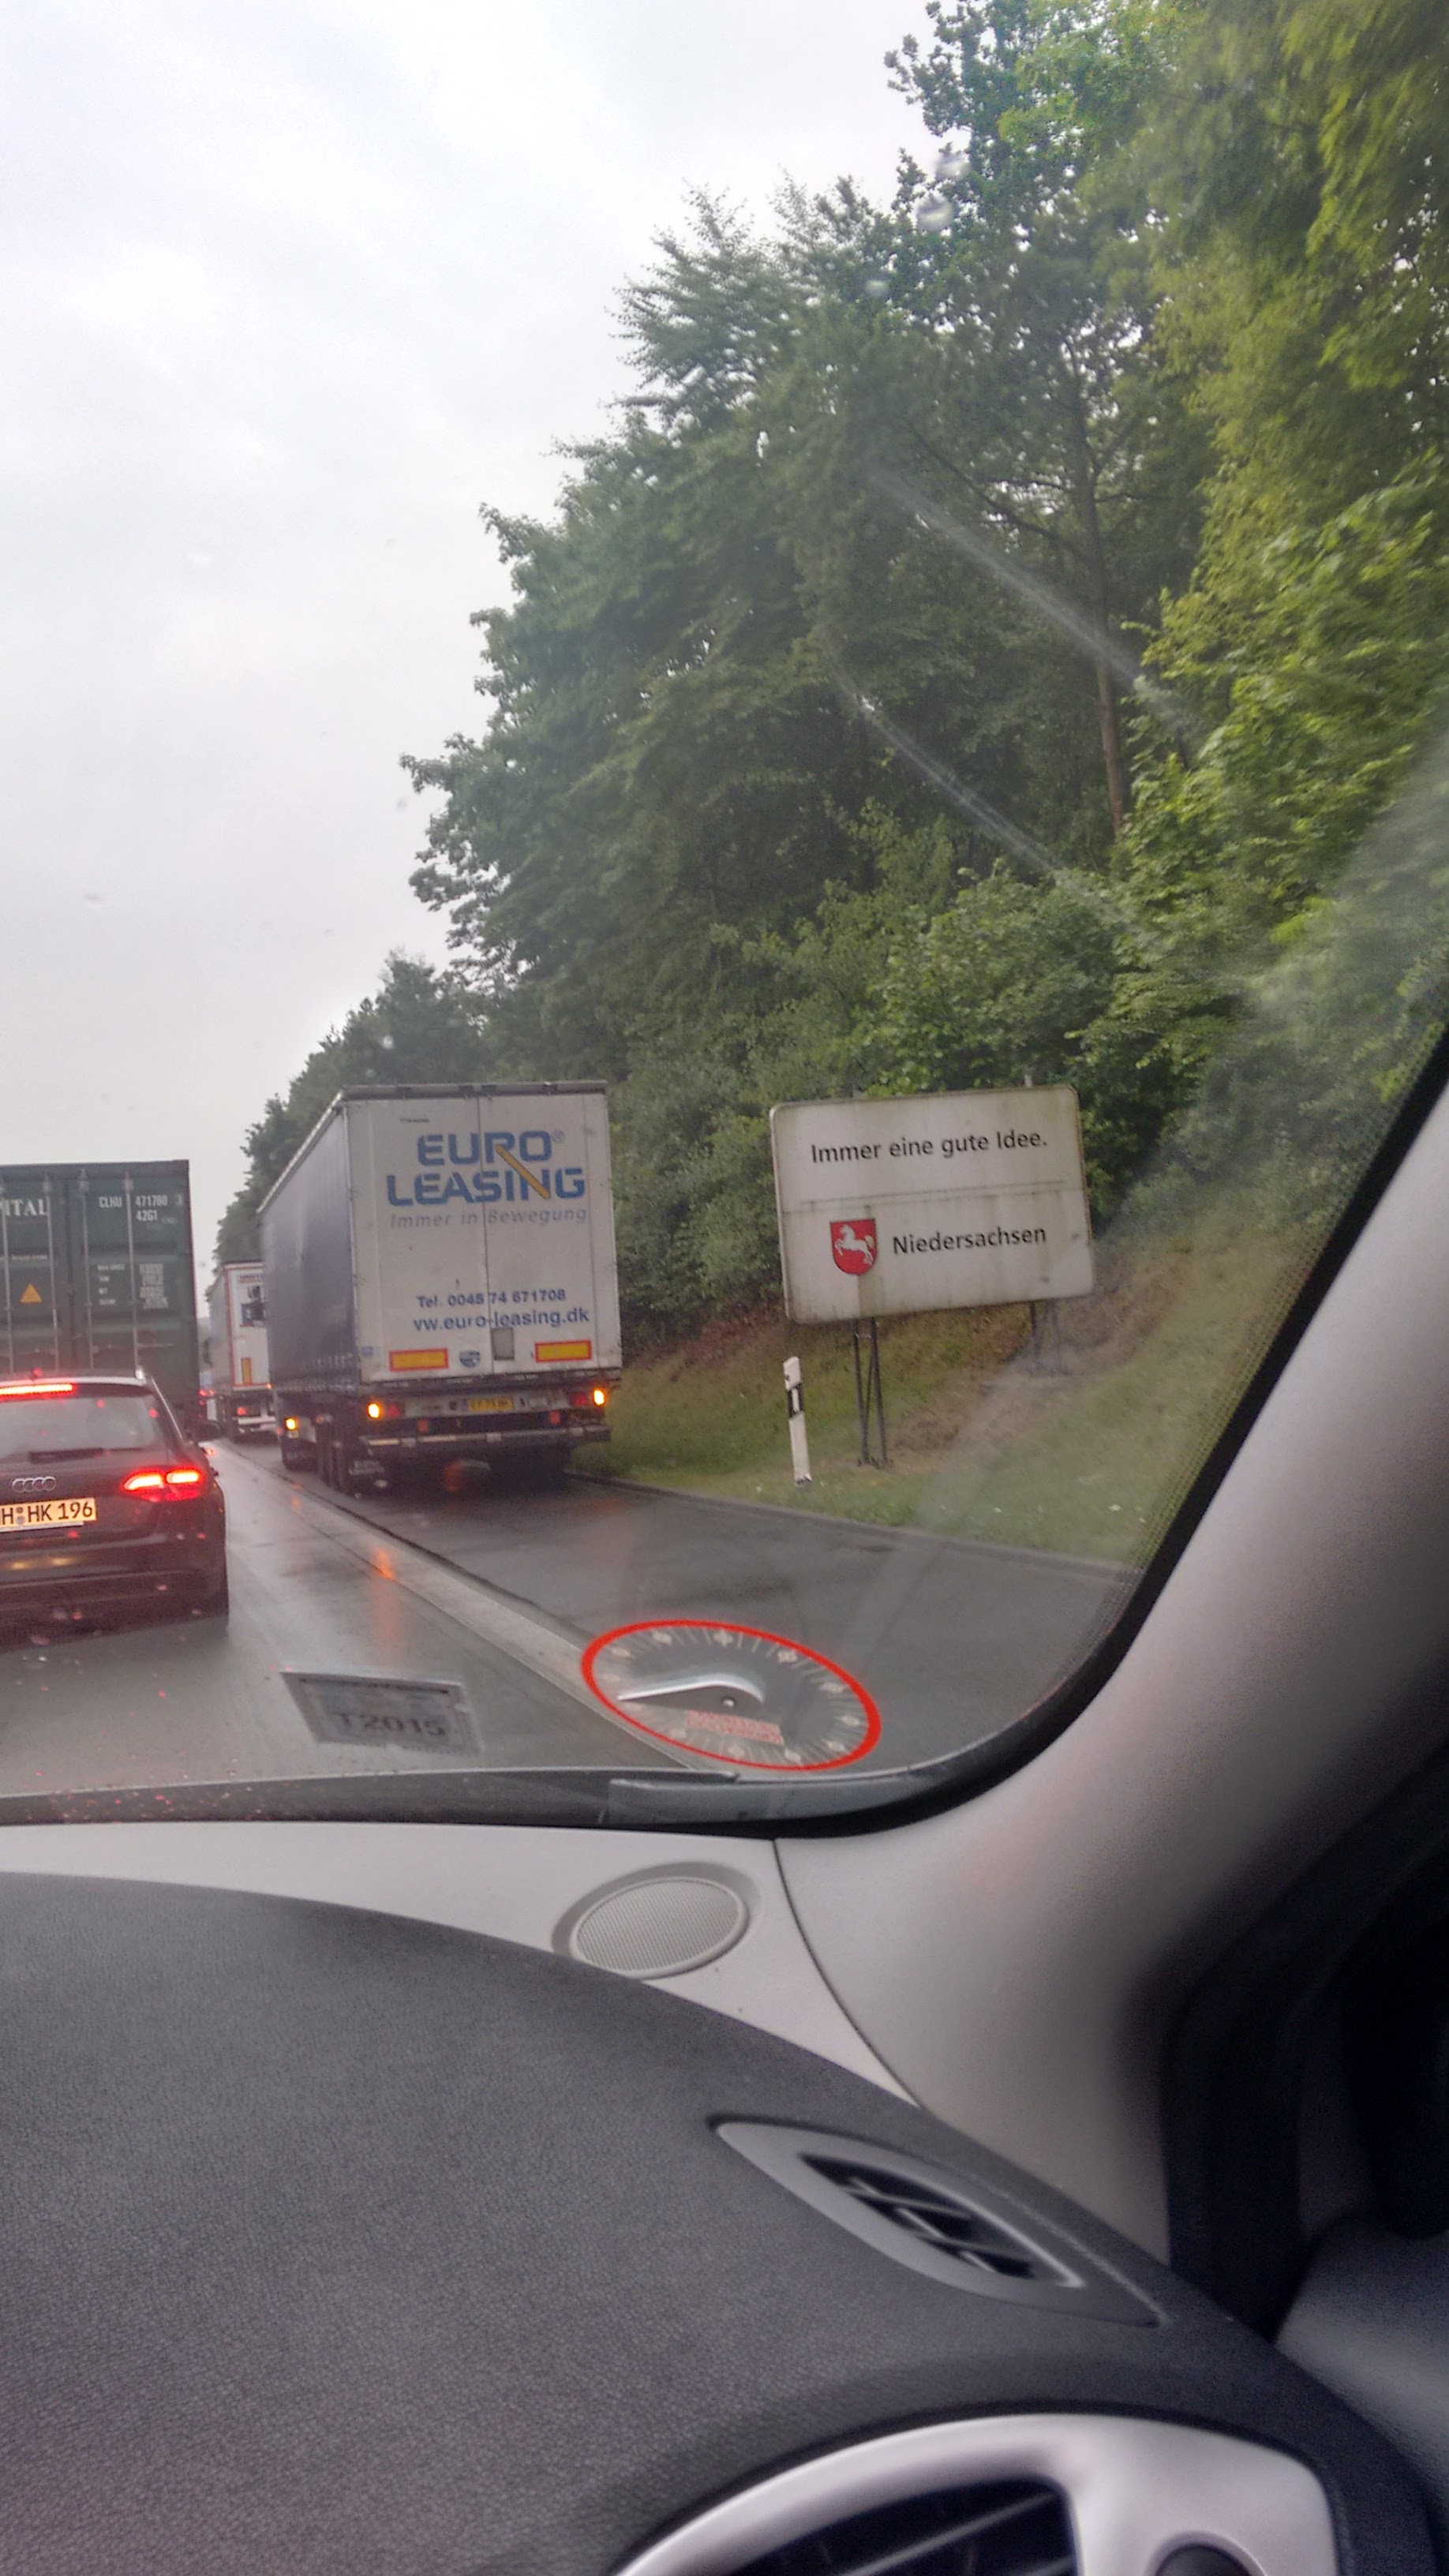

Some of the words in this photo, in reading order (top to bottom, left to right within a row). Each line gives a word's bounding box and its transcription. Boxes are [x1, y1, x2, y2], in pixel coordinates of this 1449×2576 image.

[417, 1129, 552, 1166] EURO
[811, 1143, 882, 1163] Immer
[889, 1136, 934, 1158] eine
[941, 1133, 989, 1159] gute
[996, 1129, 1047, 1151] Idee.
[386, 1167, 586, 1207] LEASING
[390, 1212, 452, 1229] Immer
[462, 1210, 481, 1225] in
[487, 1208, 588, 1226] Bewegung
[892, 1225, 1046, 1256] Niedersachsen
[489, 1291, 507, 1305] 74
[28, 1504, 52, 1523] HK
[58, 1501, 92, 1520] 196
